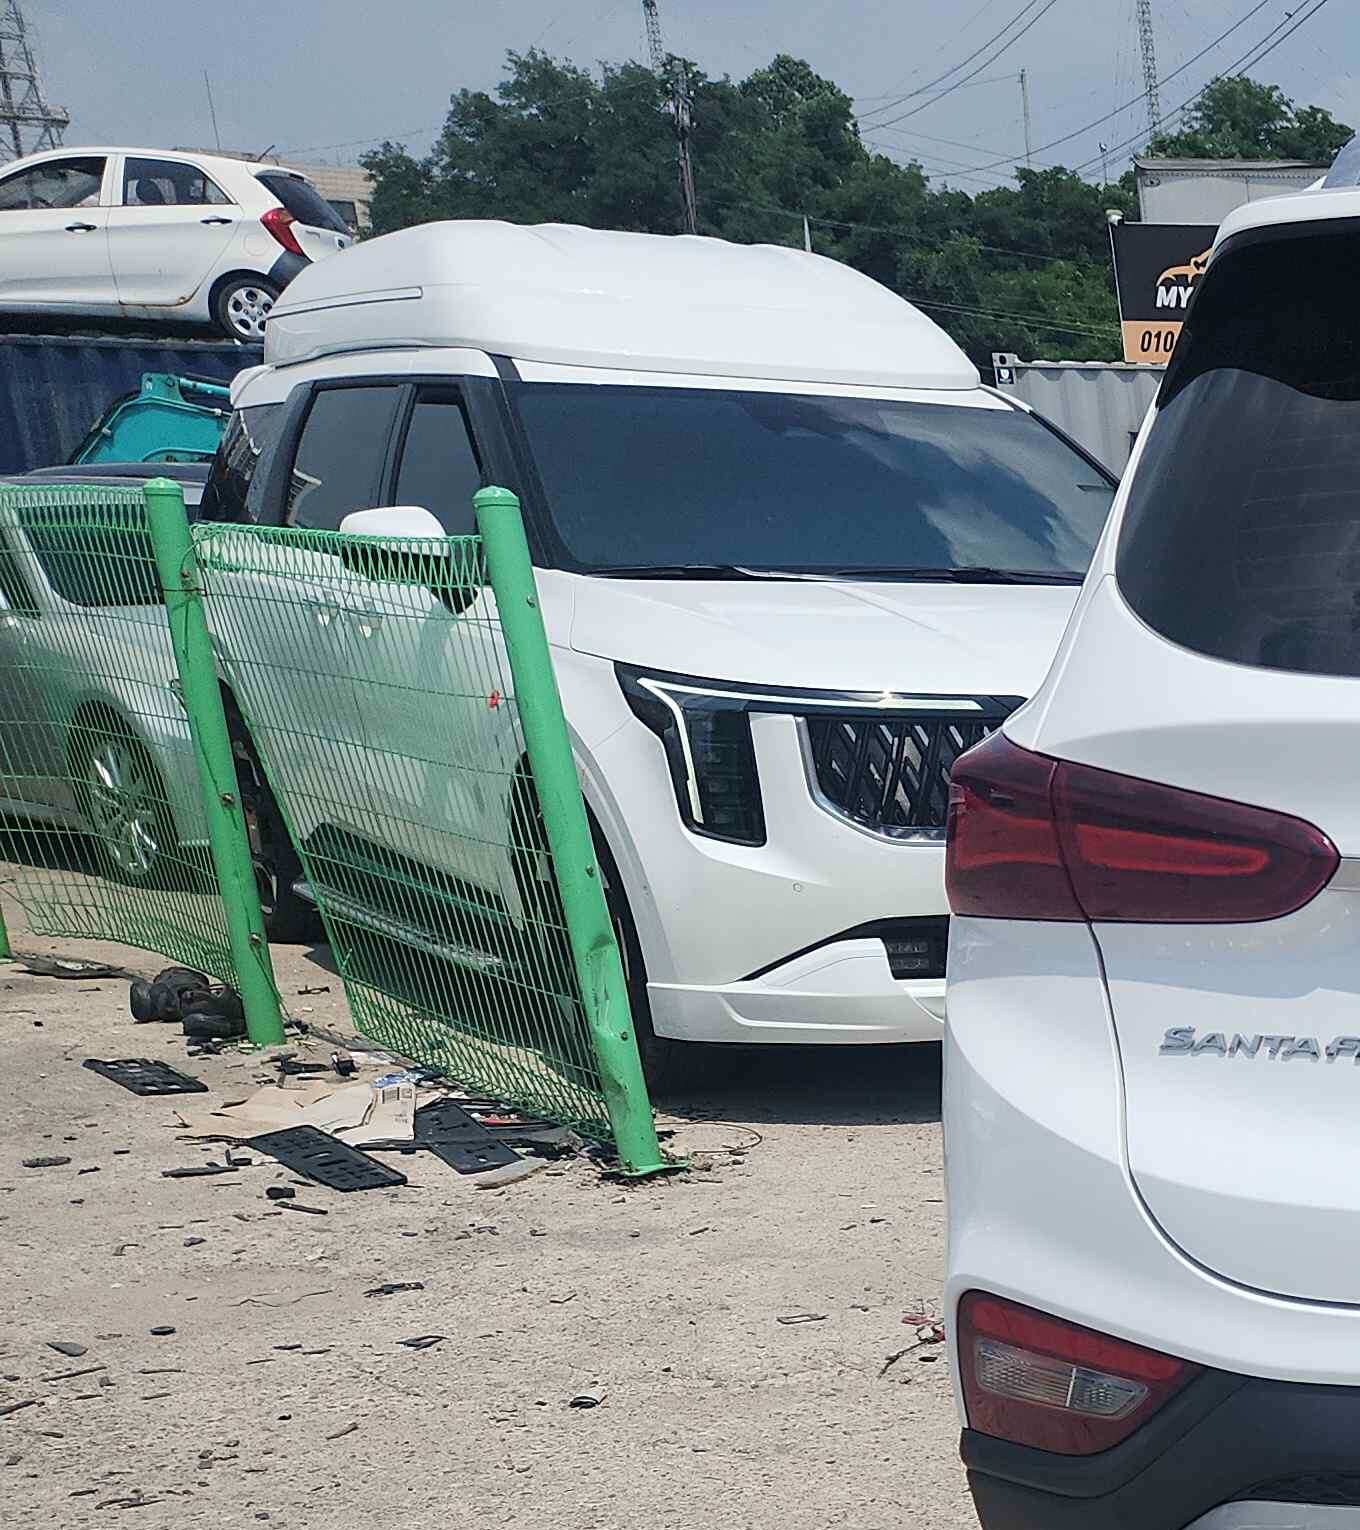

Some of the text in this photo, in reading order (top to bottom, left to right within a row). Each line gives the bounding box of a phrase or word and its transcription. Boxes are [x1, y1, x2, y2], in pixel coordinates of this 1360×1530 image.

[1155, 285, 1194, 309] MY
[1140, 330, 1175, 353] 010
[1159, 1025, 1321, 1063] SANTA
